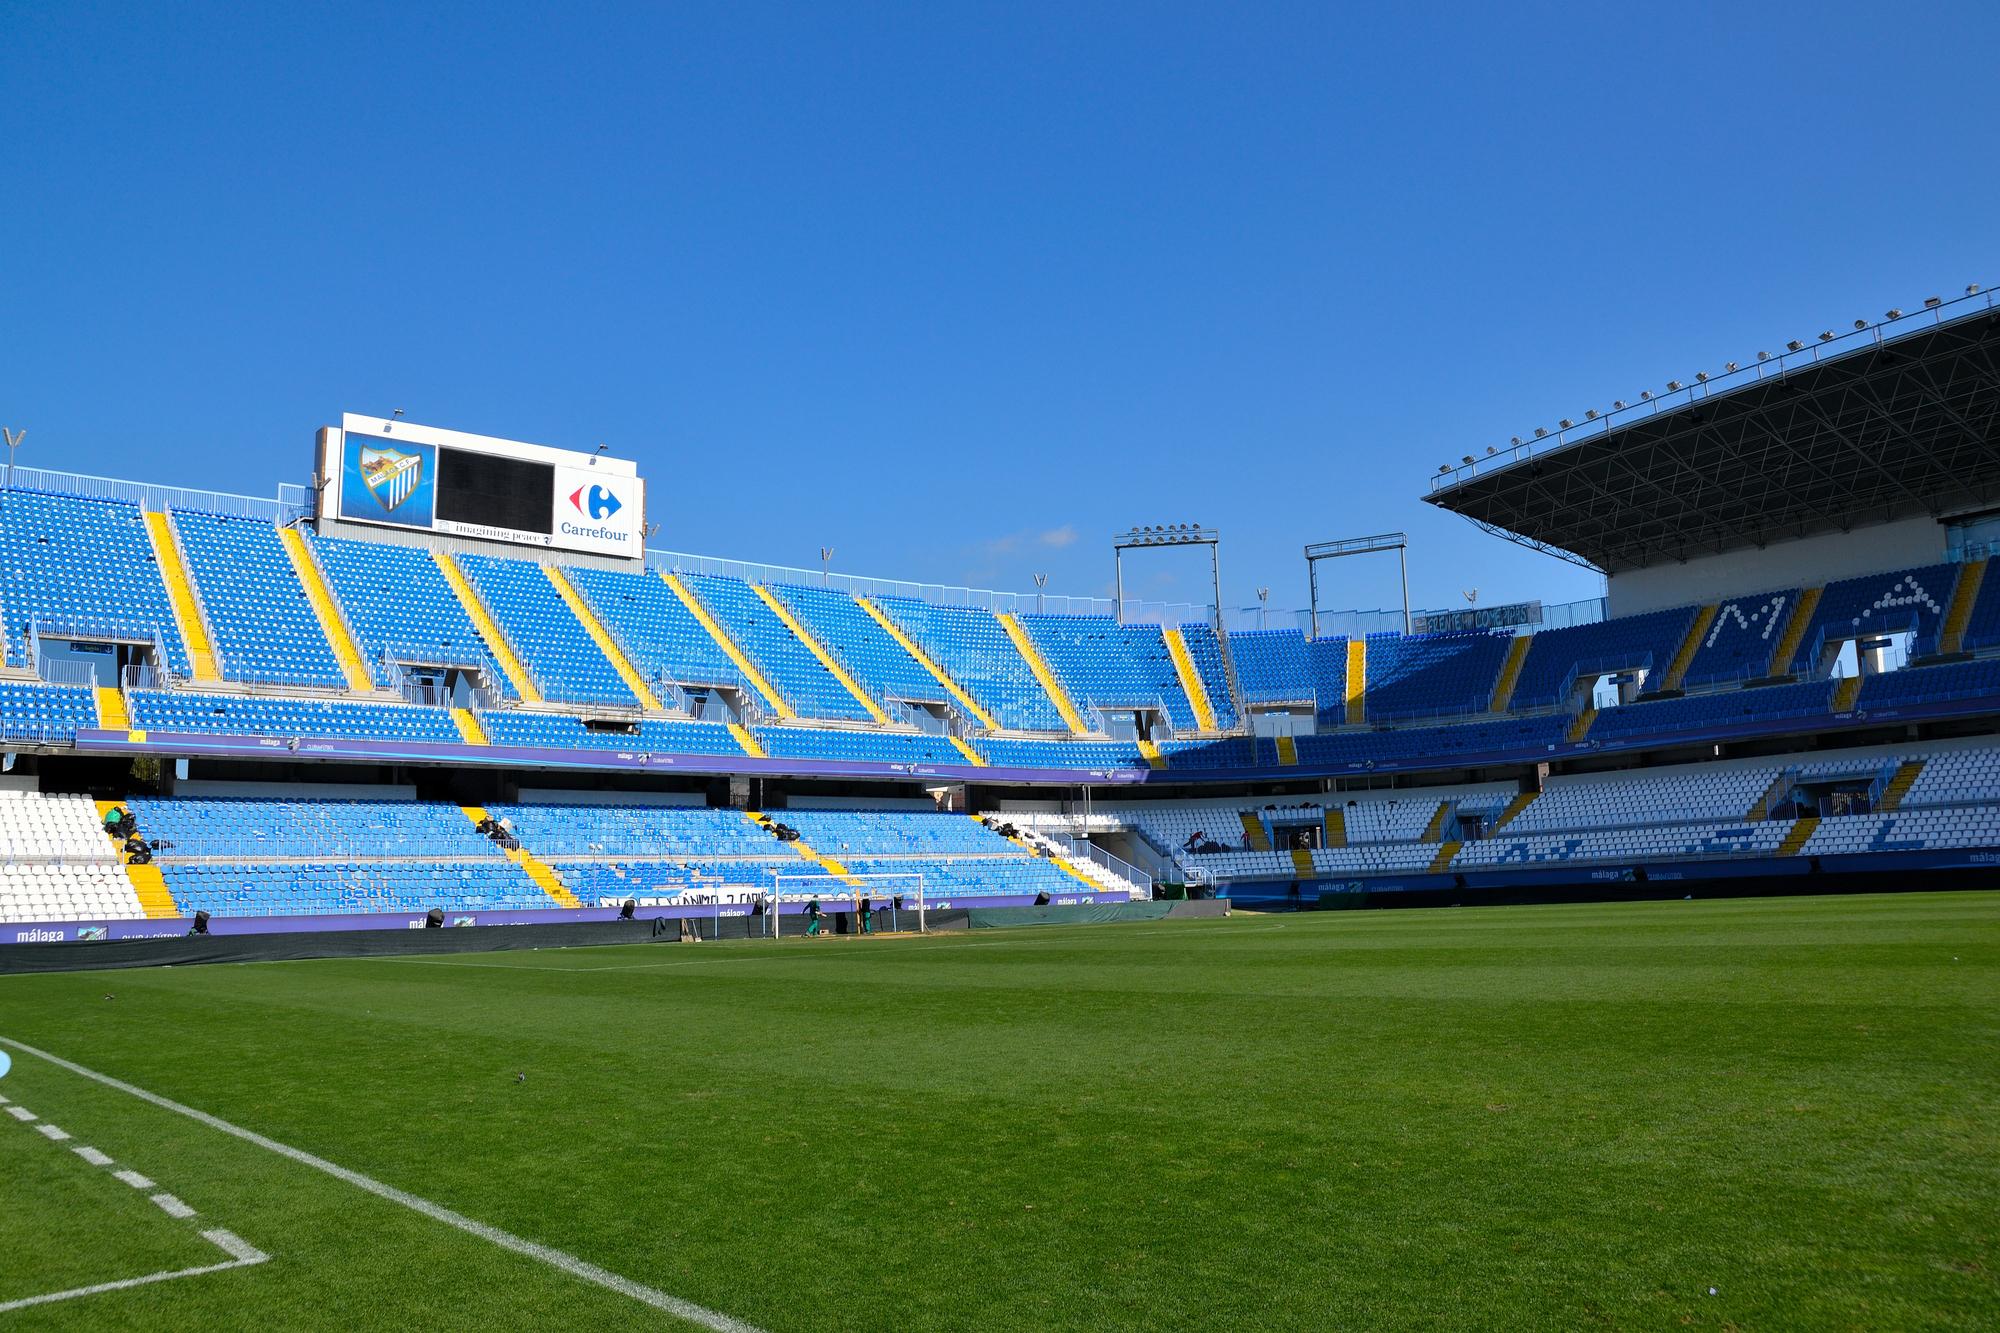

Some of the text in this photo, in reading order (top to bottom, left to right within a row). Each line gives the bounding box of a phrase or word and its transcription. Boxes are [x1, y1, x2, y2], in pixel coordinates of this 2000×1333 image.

[456, 522, 540, 541] imagining peace
[561, 522, 629, 541] Carrefour
[1592, 869, 1619, 879] málaga
[1318, 882, 1345, 891] málaga
[17, 929, 64, 942] málaga
